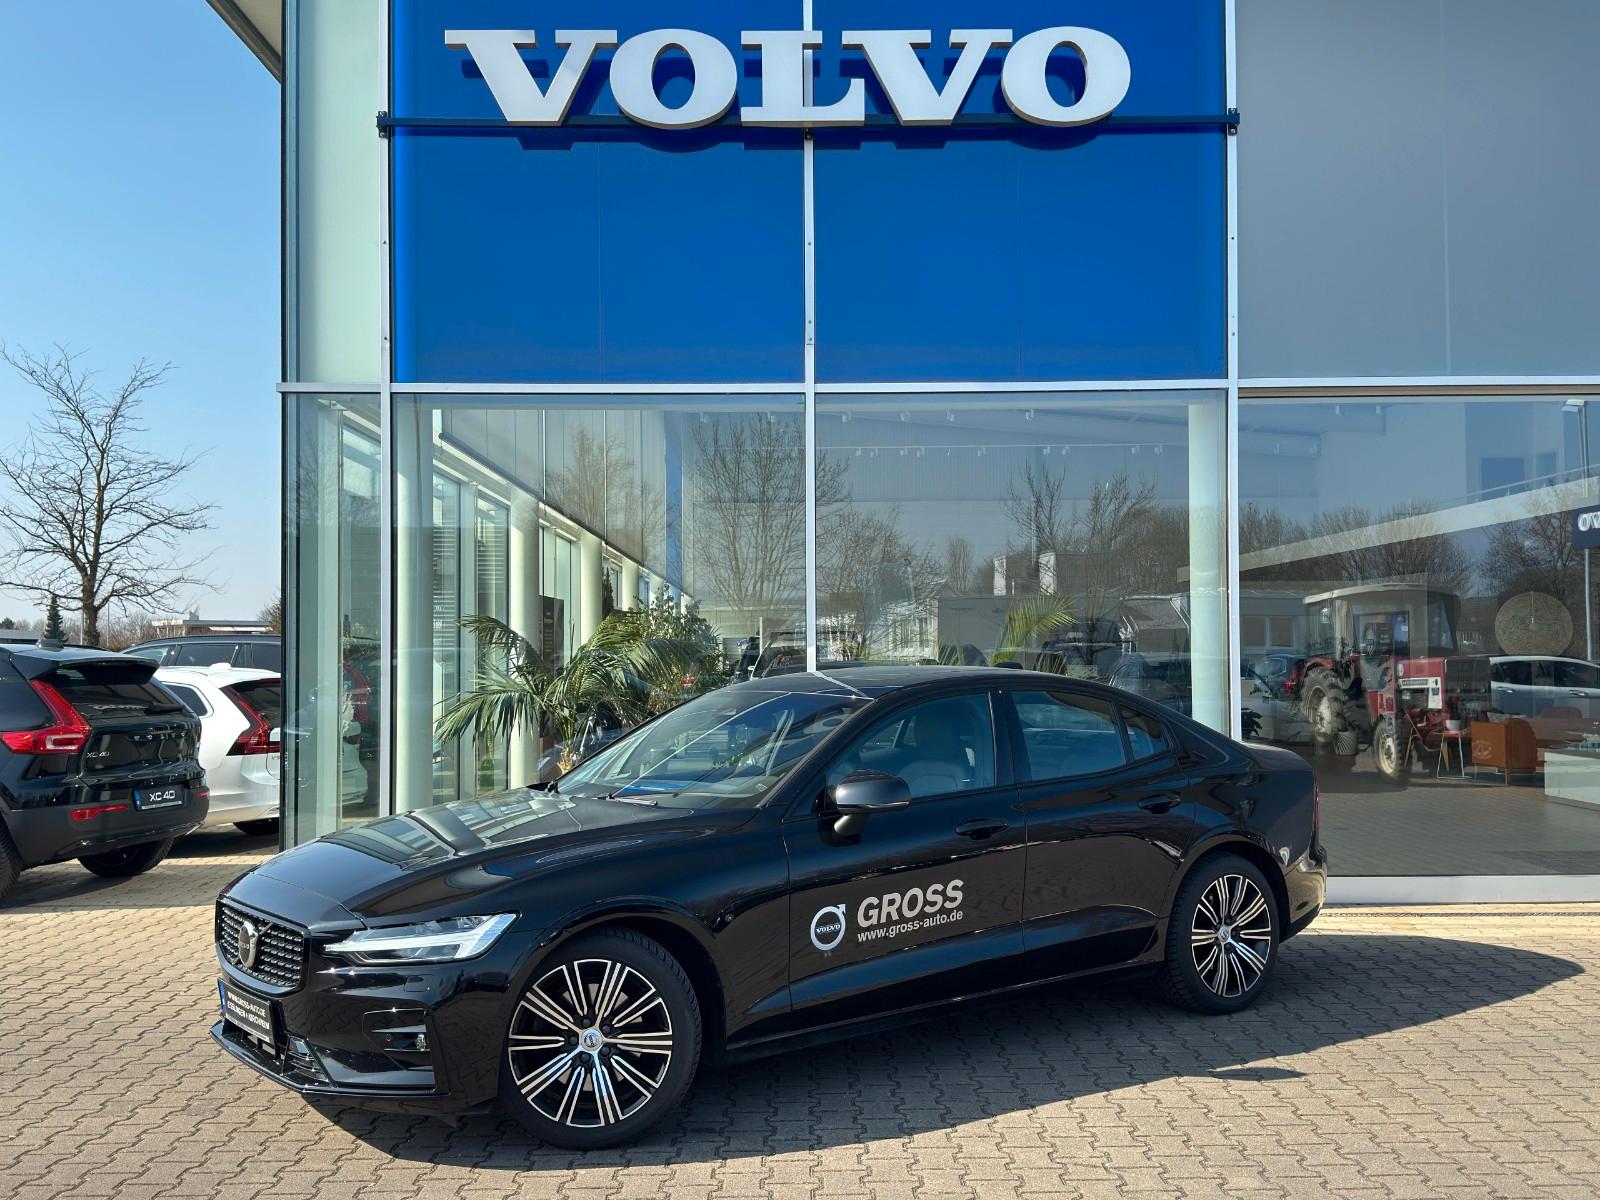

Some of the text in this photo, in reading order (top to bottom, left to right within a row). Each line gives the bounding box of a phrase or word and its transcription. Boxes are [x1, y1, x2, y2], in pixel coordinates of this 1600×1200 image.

[444, 26, 1132, 130] VOLVO
[857, 879, 964, 928] GROSS
[816, 923, 841, 933] VOLVO
[857, 909, 963, 943] www.gross-auto.de
